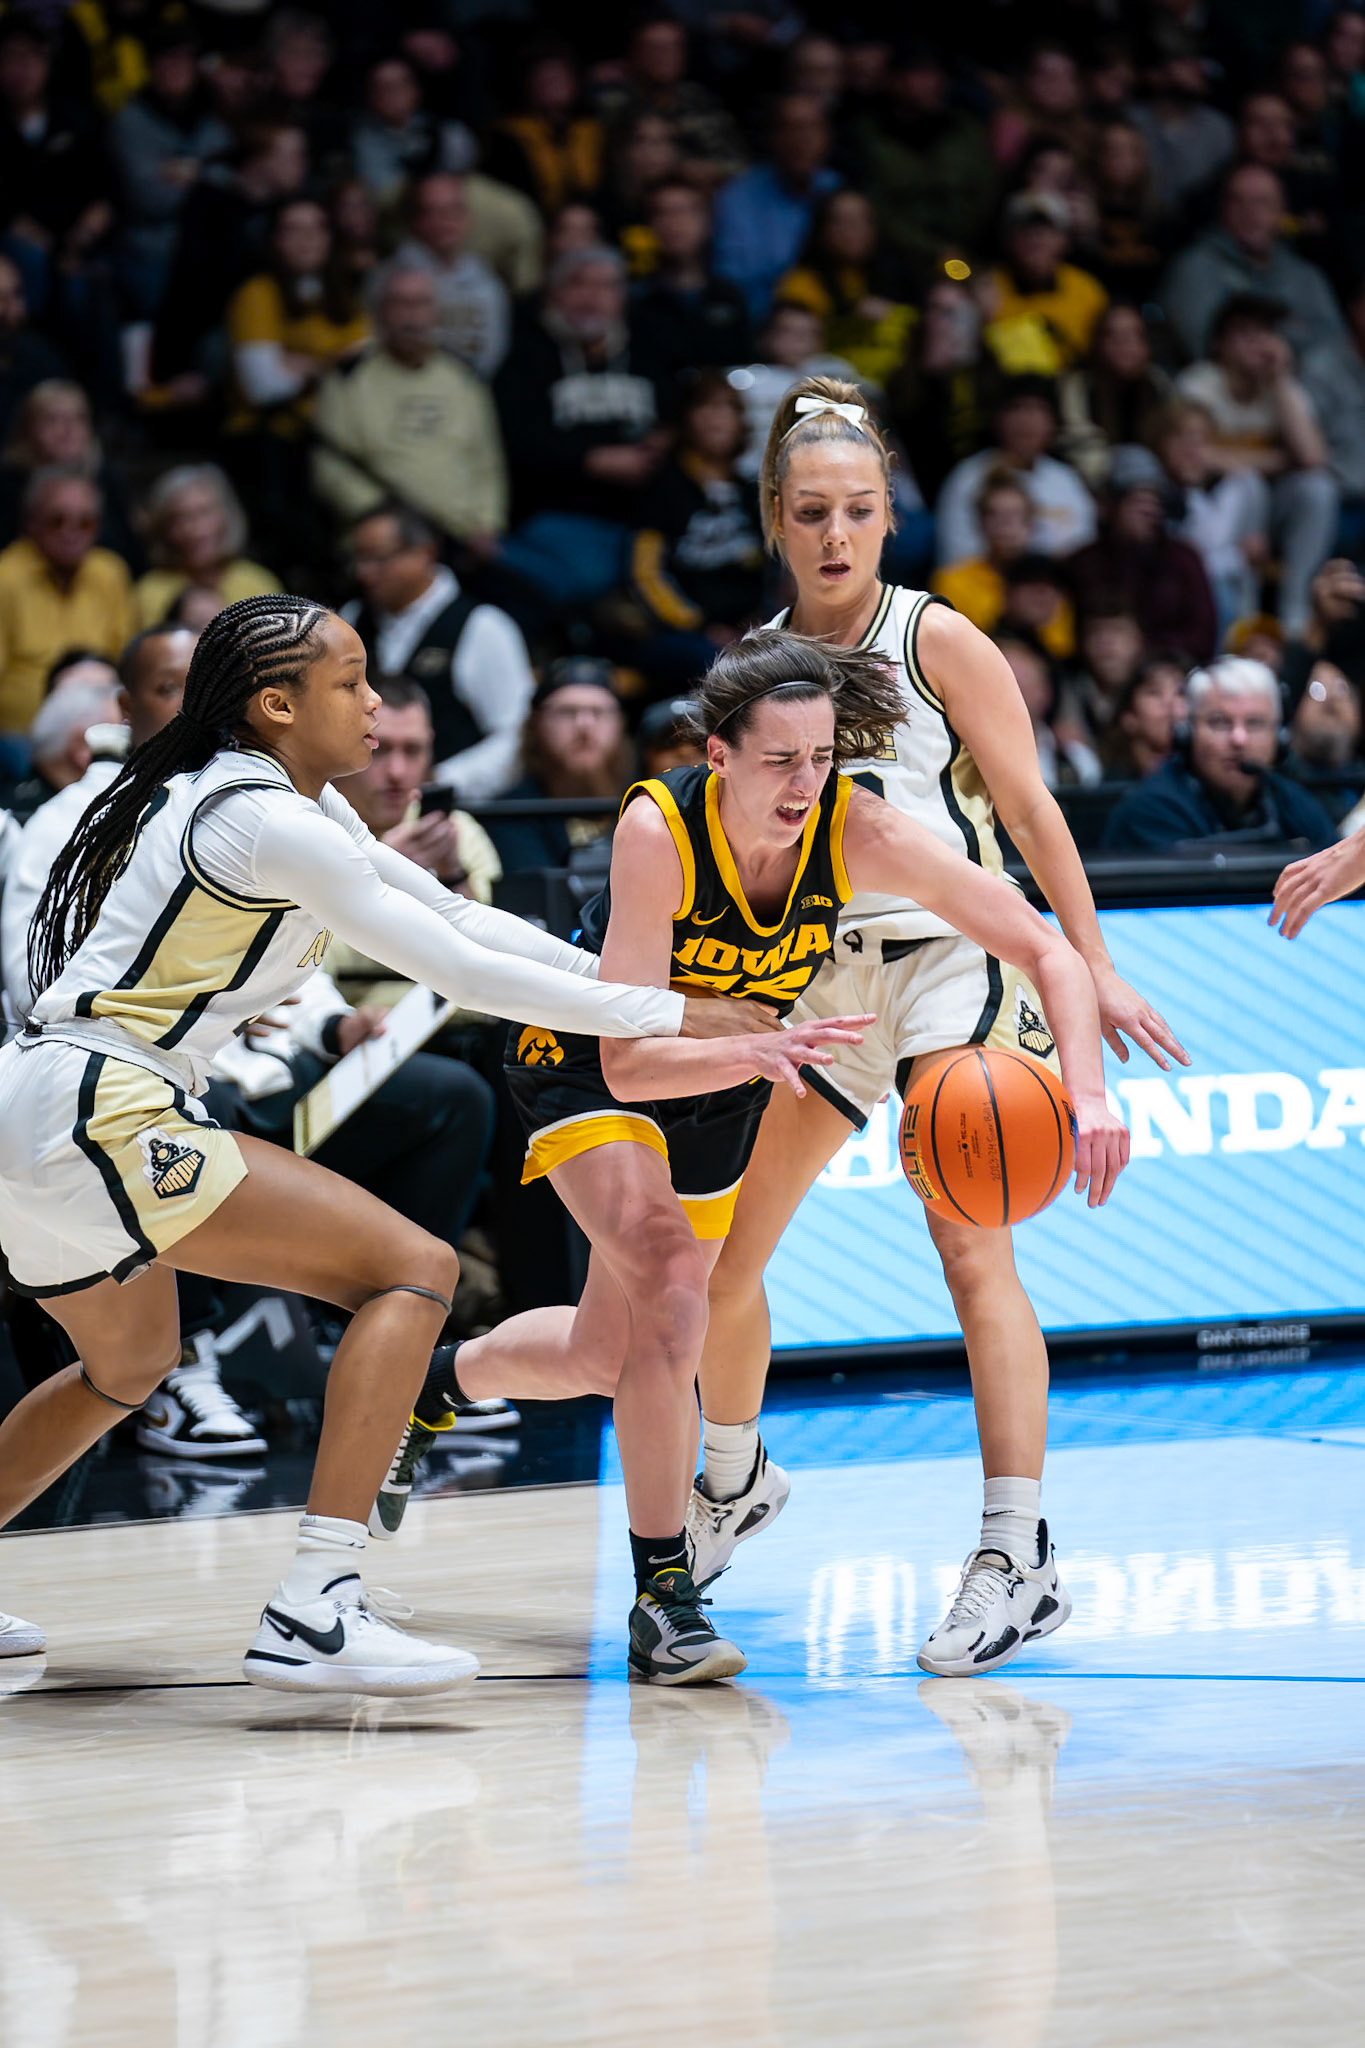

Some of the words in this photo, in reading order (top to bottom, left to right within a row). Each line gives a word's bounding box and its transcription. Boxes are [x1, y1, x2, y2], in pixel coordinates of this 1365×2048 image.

[672, 923, 833, 977] IOWA
[1103, 1067, 1365, 1159] NDA
[155, 1151, 203, 1196] PURDUE
[902, 1103, 933, 1200] ELITE
